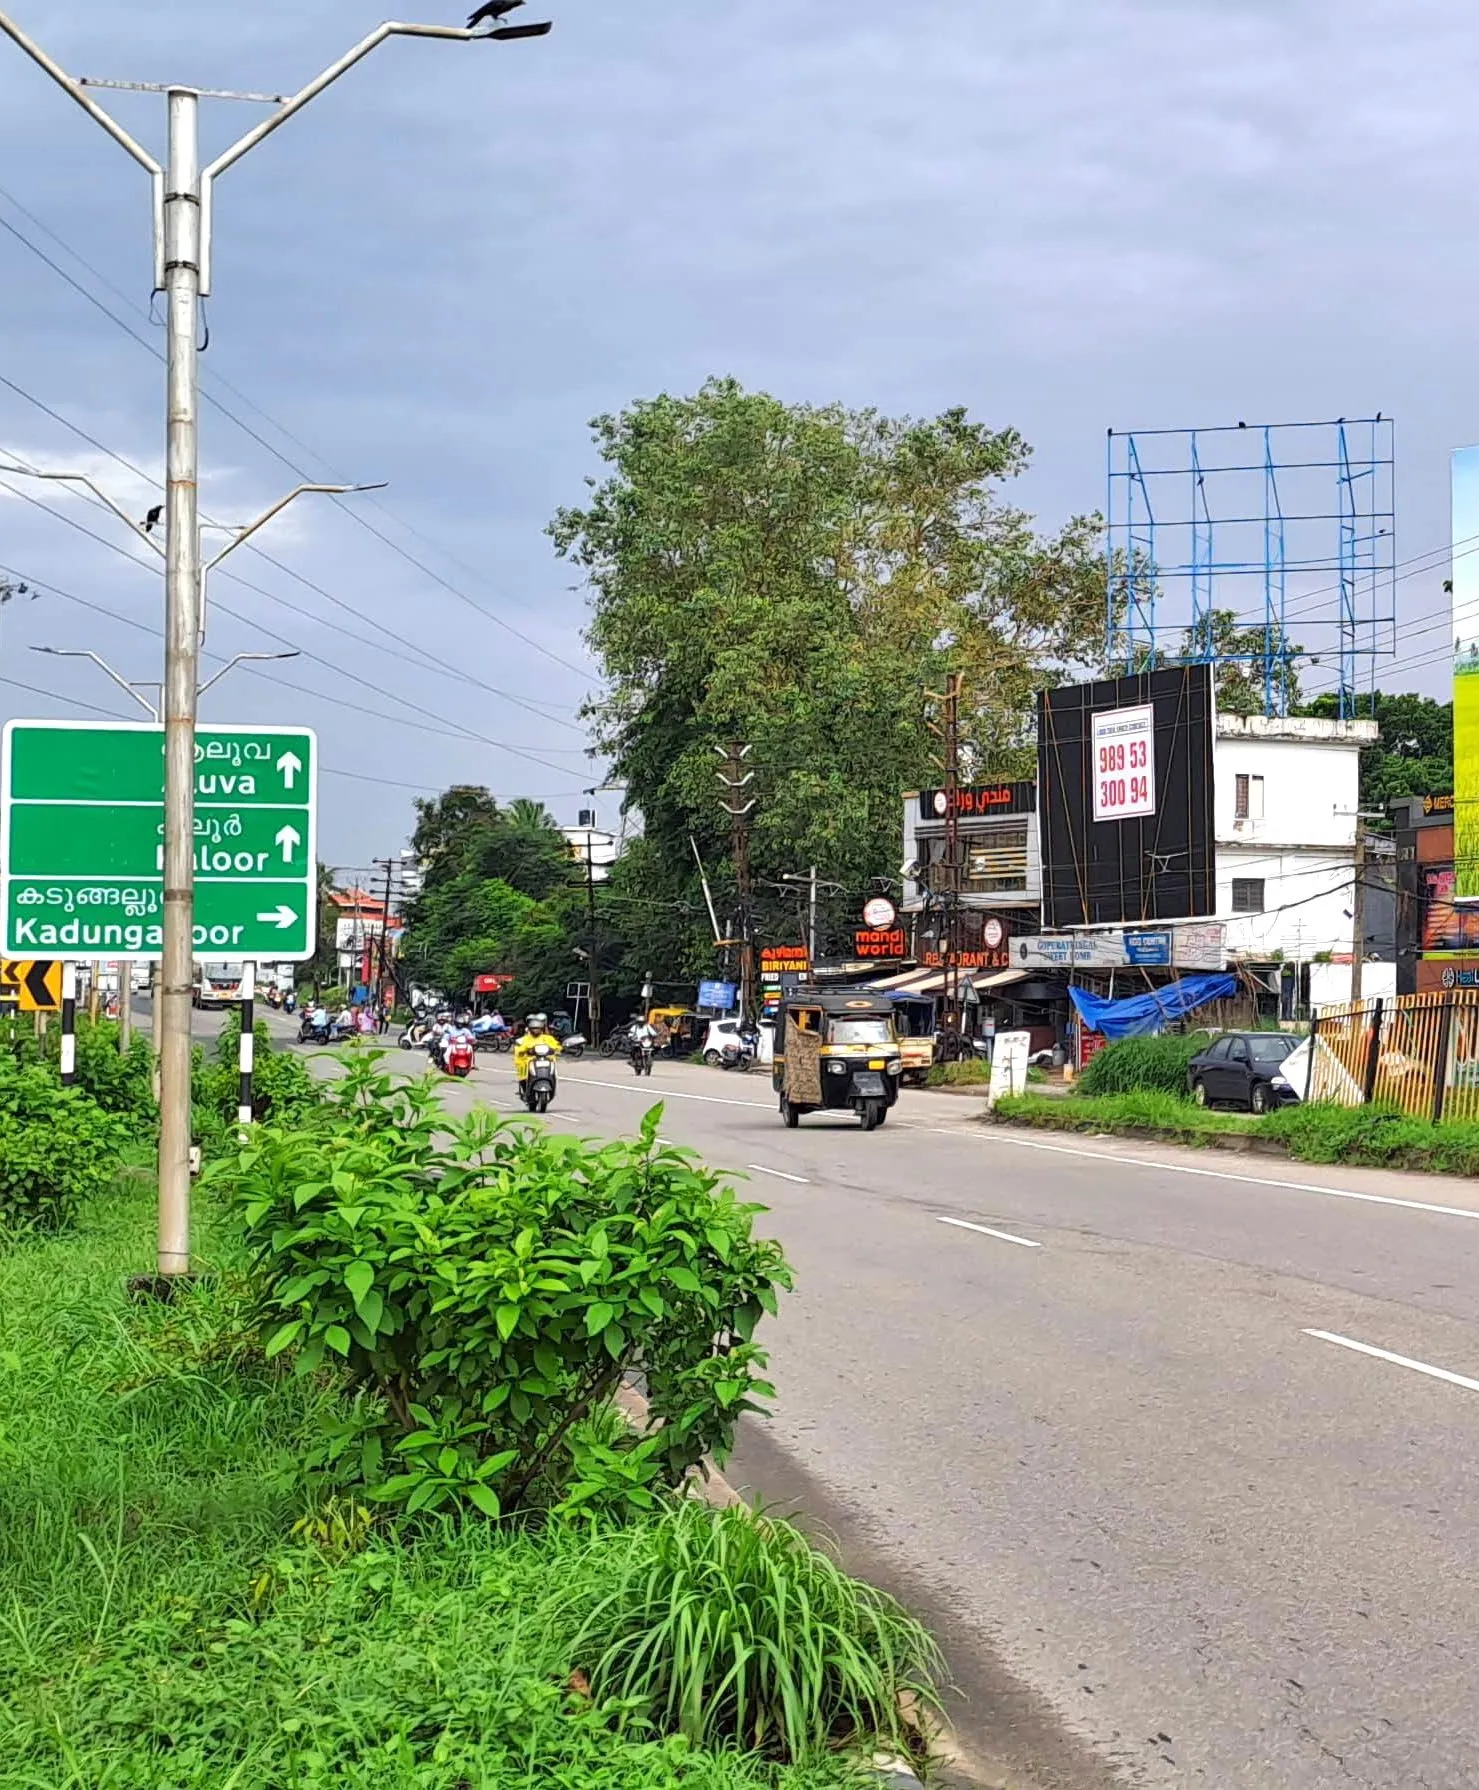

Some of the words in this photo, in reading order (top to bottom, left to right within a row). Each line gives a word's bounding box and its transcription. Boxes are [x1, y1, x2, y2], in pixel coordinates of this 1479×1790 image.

[1100, 744, 1125, 773] 989
[1130, 741, 1147, 768] 53
[161, 772, 256, 795] uva
[1101, 779, 1126, 807] 300
[1131, 775, 1148, 803] 94
[15, 916, 245, 950] Kadungaoor
[856, 928, 904, 942] mandi
[856, 942, 904, 956] world
[761, 960, 807, 972] BIRIYANI
